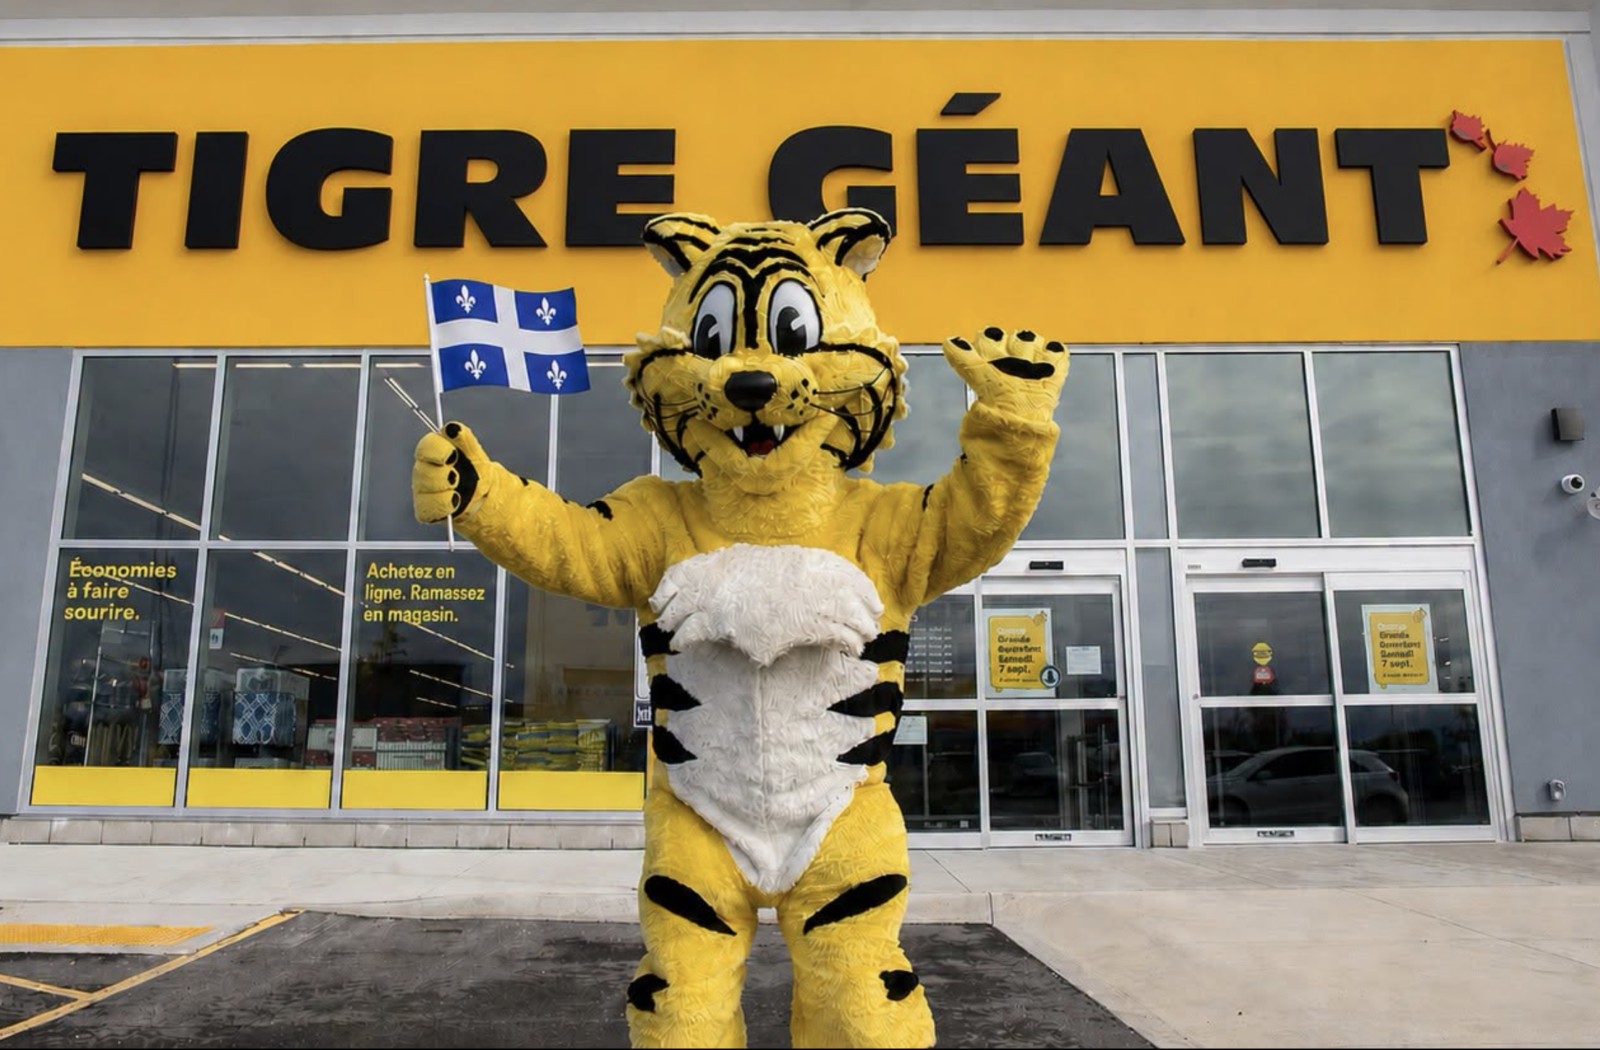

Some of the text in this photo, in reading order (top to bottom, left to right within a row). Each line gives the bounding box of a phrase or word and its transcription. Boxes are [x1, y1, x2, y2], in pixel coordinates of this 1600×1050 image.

[52, 91, 1450, 250] TIGRE GÉANT
[69, 556, 177, 579] Économies
[366, 561, 455, 580] Achetez en
[66, 581, 129, 599] à faire
[364, 583, 485, 604] ligne. Ramassez
[63, 602, 140, 620] sourire.
[363, 605, 459, 626] en magasin.
